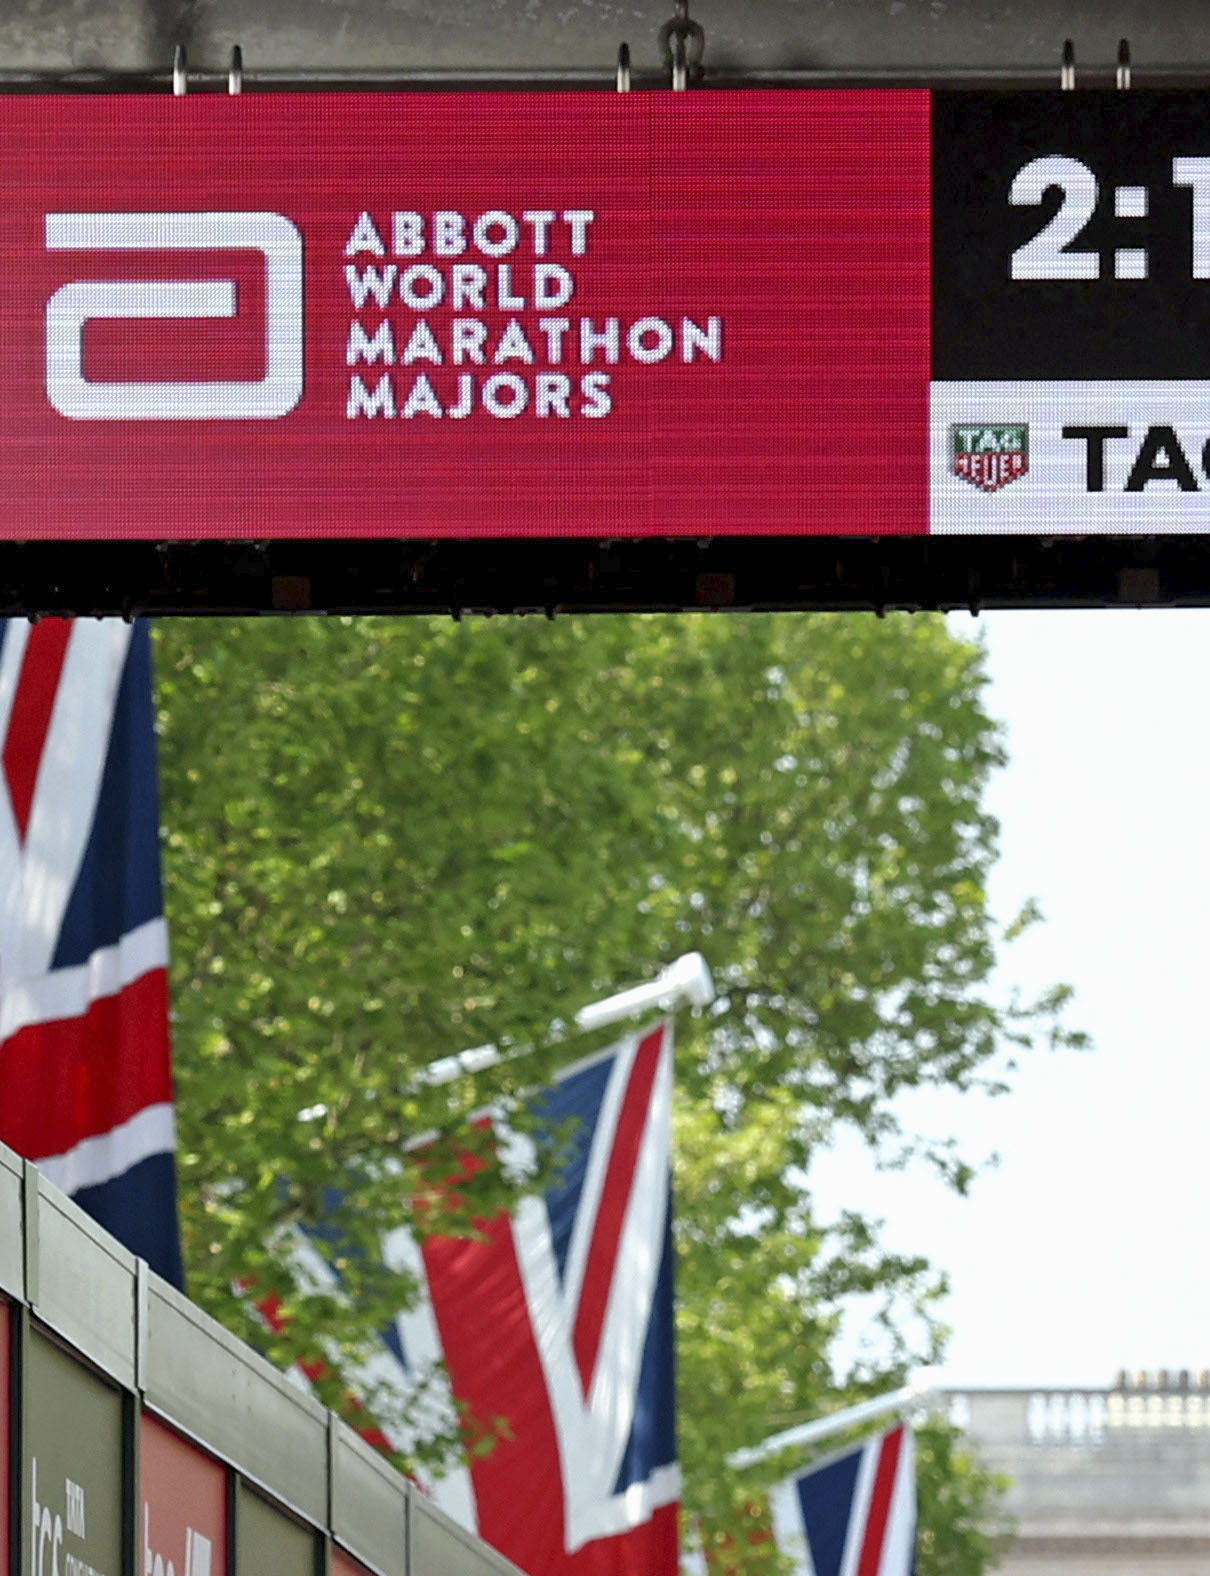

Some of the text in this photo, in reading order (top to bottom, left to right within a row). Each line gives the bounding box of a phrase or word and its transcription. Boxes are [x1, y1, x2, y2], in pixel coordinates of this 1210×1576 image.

[344, 211, 594, 256] ABBOTT
[344, 264, 573, 310] WORLD
[346, 316, 722, 364] MARATHON
[346, 372, 612, 419] MAJORS
